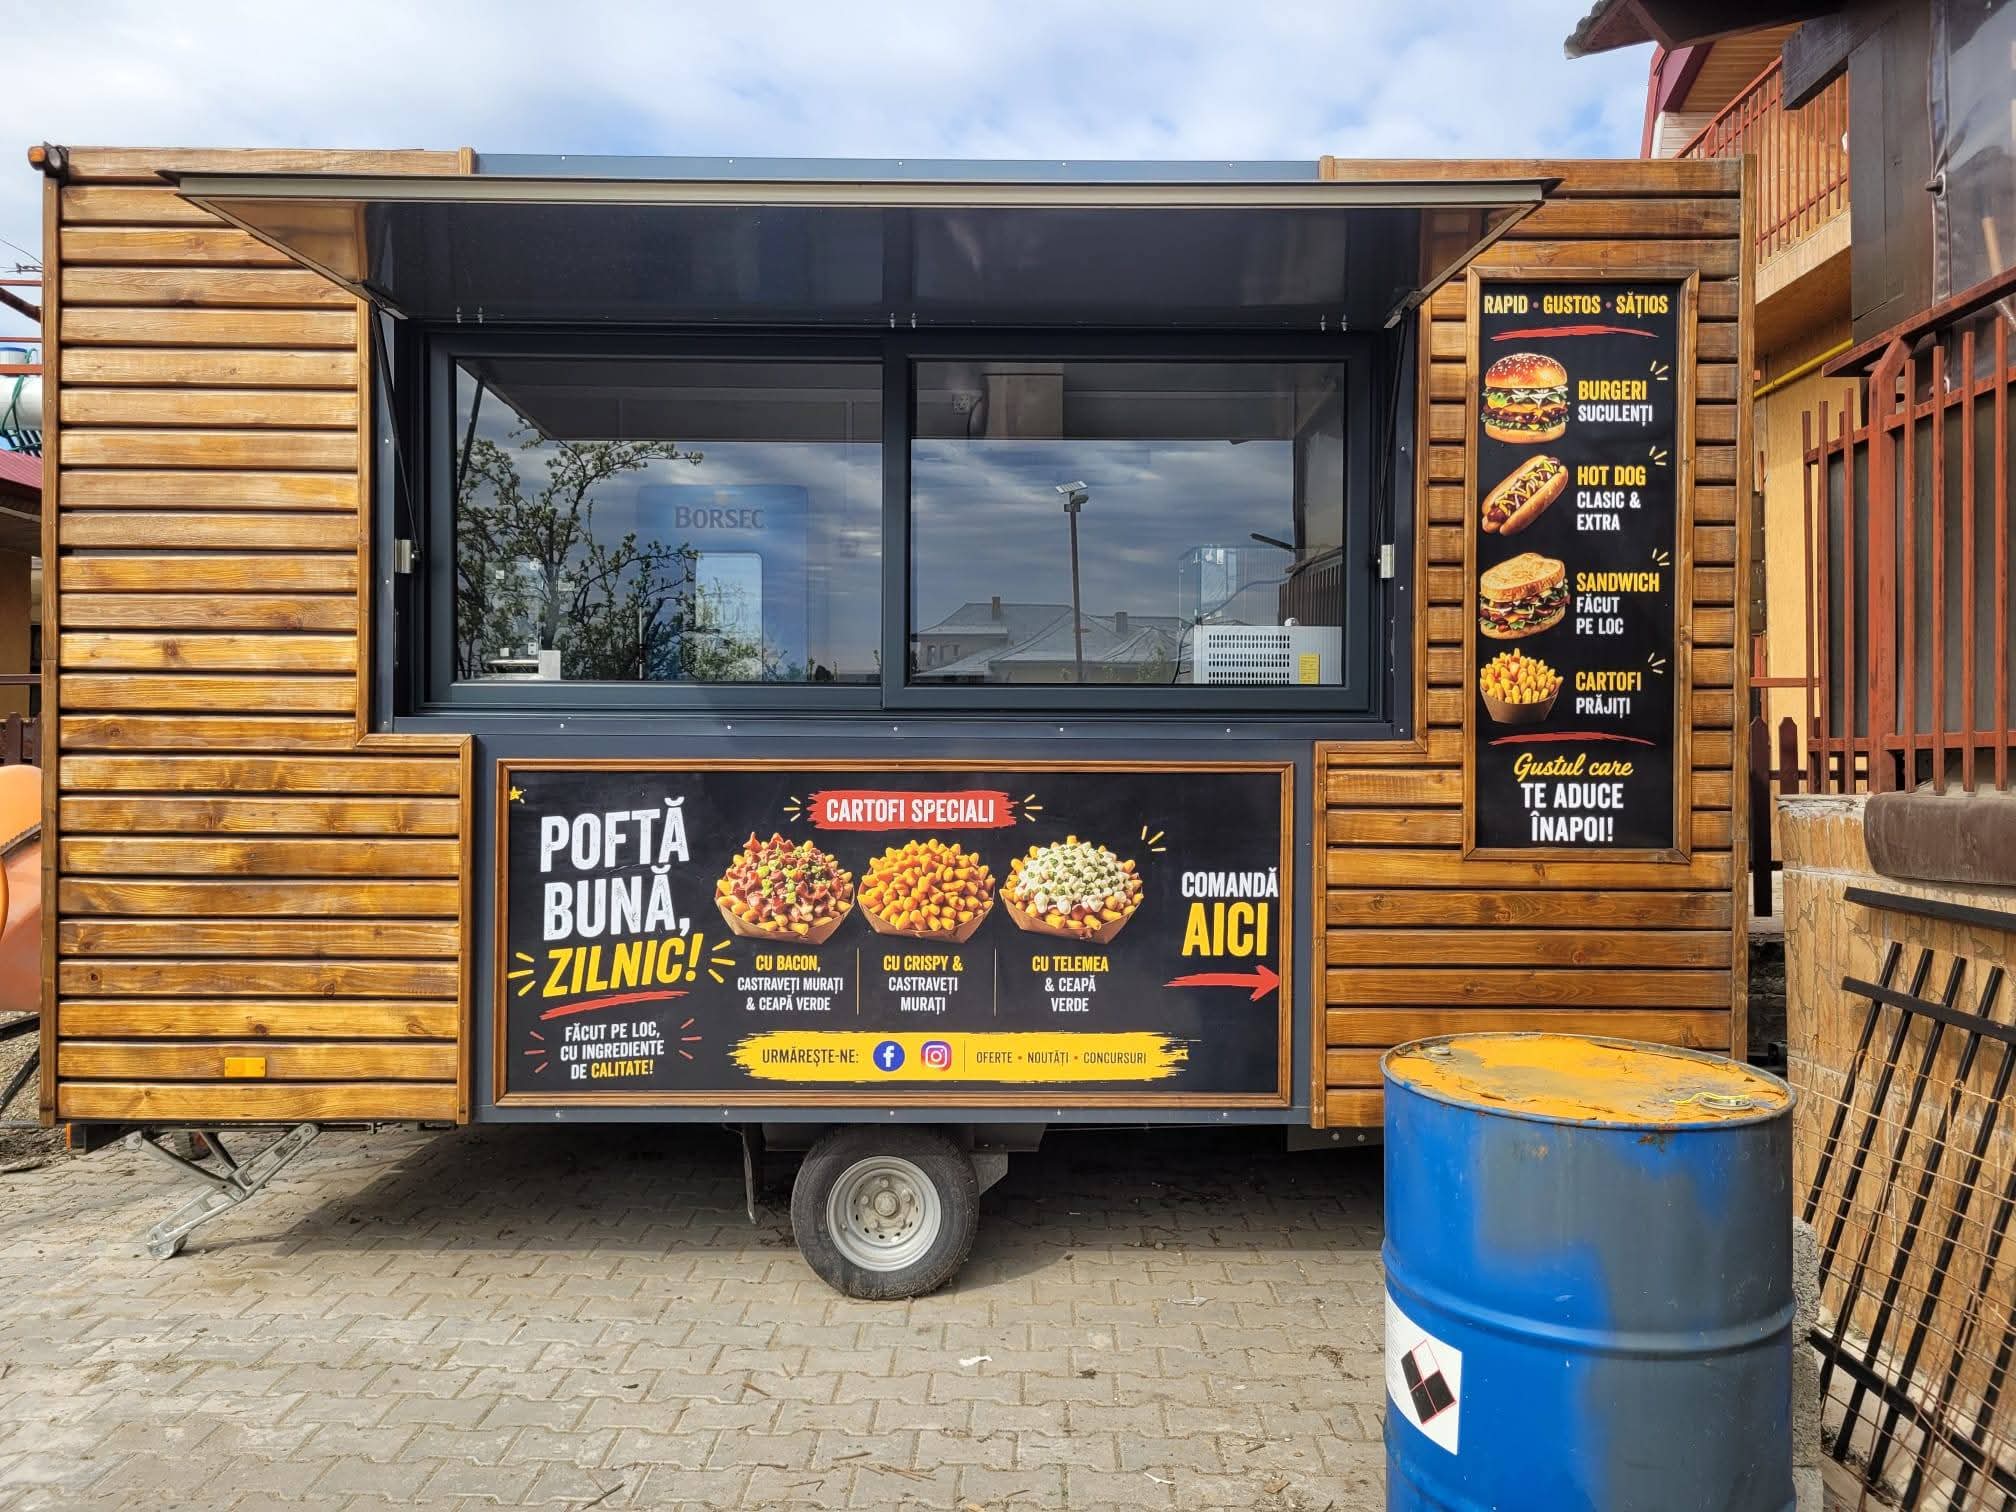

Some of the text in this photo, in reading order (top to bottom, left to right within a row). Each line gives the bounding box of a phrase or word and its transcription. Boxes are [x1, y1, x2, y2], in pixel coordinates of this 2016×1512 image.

[1484, 291, 1668, 318] RAPID GUSTOS SĂȚIOS
[1578, 380, 1647, 400] BURGERI
[1578, 405, 1652, 426] SUCULENȚI
[1577, 466, 1646, 486] HOT DOG
[1576, 492, 1641, 508] CLASIC &
[675, 506, 764, 529] BORSEC
[1577, 514, 1620, 530] EXTRA
[1576, 572, 1660, 592] SANDWICH
[1576, 594, 1620, 613] FĂCUT
[1576, 618, 1624, 634] PE LOC
[1576, 672, 1641, 691] CARTOFI
[1576, 694, 1630, 718] PRĂJIȚI
[1514, 752, 1633, 782] Gustul care
[1521, 783, 1624, 809] TE ADUCE
[827, 799, 994, 823] CARTOFI SPECIALI
[540, 796, 690, 872] POFTĂ
[1530, 810, 1613, 842] ÎNAPOI!
[1182, 867, 1279, 897] COMANDĂ
[543, 864, 690, 941] BUNĂ,
[1182, 902, 1267, 956] AICI
[542, 933, 704, 998] ZILNIC!
[756, 955, 821, 972] CU BACON,
[883, 956, 963, 971] CU CRISPY &
[1032, 956, 1109, 972] CU TELEMEA
[738, 977, 843, 994] CASTRAVEȚI MURAȚI
[888, 977, 958, 994] CASTRAVEȚI
[1045, 975, 1096, 992] & CEAPĂ
[746, 995, 831, 1010] & CEAPĂ VERDE
[900, 997, 946, 1015] MURAȚI
[1051, 998, 1089, 1012] VERDE
[565, 1021, 660, 1041] FĂCUT PE LOC,
[560, 1040, 664, 1061] CU INGREDIENTE
[762, 1047, 859, 1067] URMĂREȘTE-NE:
[976, 1050, 1146, 1066] OFERTE NOUTĂȚI CONCURSURI
[571, 1059, 654, 1079] DE CALITATE!
